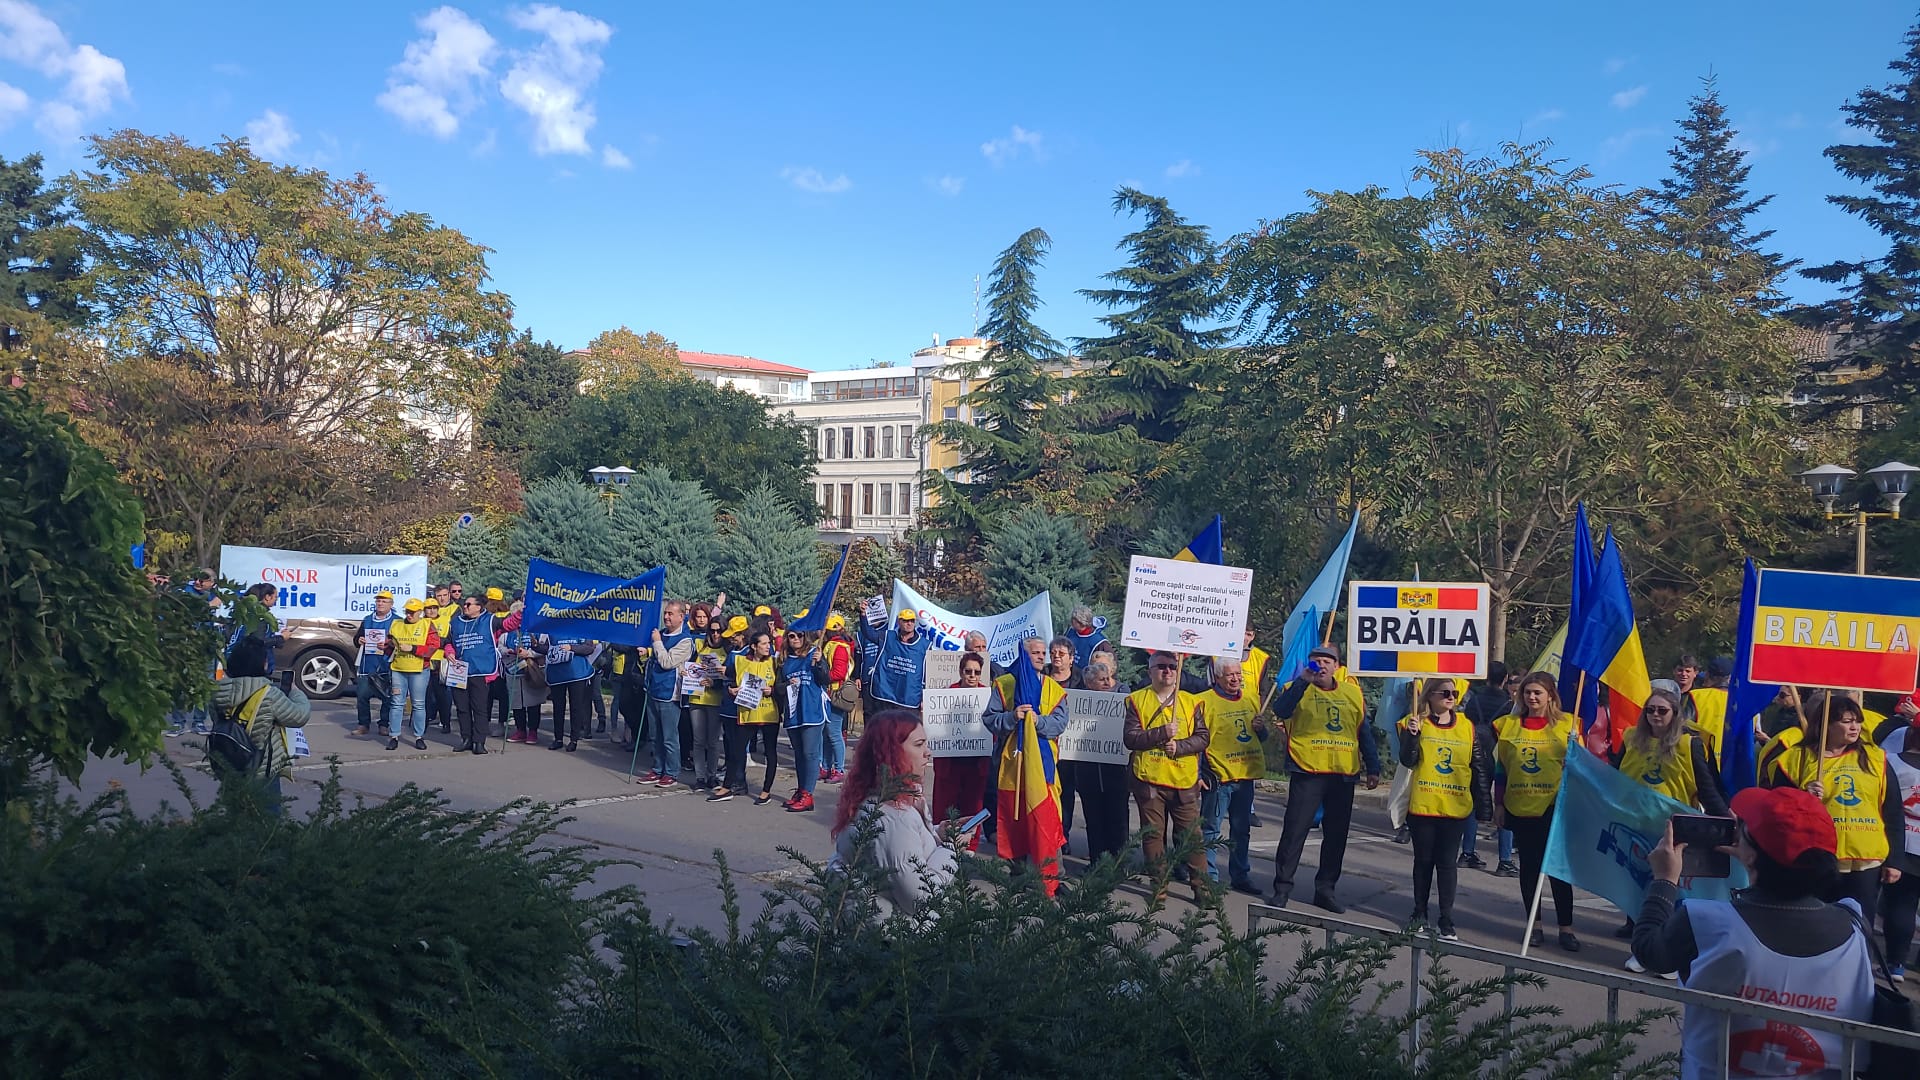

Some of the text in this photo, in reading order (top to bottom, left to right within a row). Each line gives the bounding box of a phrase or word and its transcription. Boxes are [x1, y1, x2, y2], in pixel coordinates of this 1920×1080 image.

[262, 568, 318, 584] CNSLR
[352, 565, 398, 578] Uniunea
[534, 578, 588, 603] Sindicatul
[1144, 580, 1166, 588] punem
[351, 600, 376, 612] Gala
[1187, 594, 1222, 605] salariile
[1224, 598, 1227, 606] !
[612, 606, 642, 628] Galați
[1140, 600, 1234, 618] Impozitați profiturile !
[918, 610, 970, 640] CNSLR
[998, 614, 1028, 632] Uniunea
[1138, 610, 1234, 628] Investiți pentru viitor !
[1358, 610, 1480, 646] BRĂILA
[1764, 611, 1910, 652] BRĂILA
[930, 695, 980, 710] STOPAREA
[952, 728, 962, 736] LA
[1442, 783, 1467, 791] HARET
